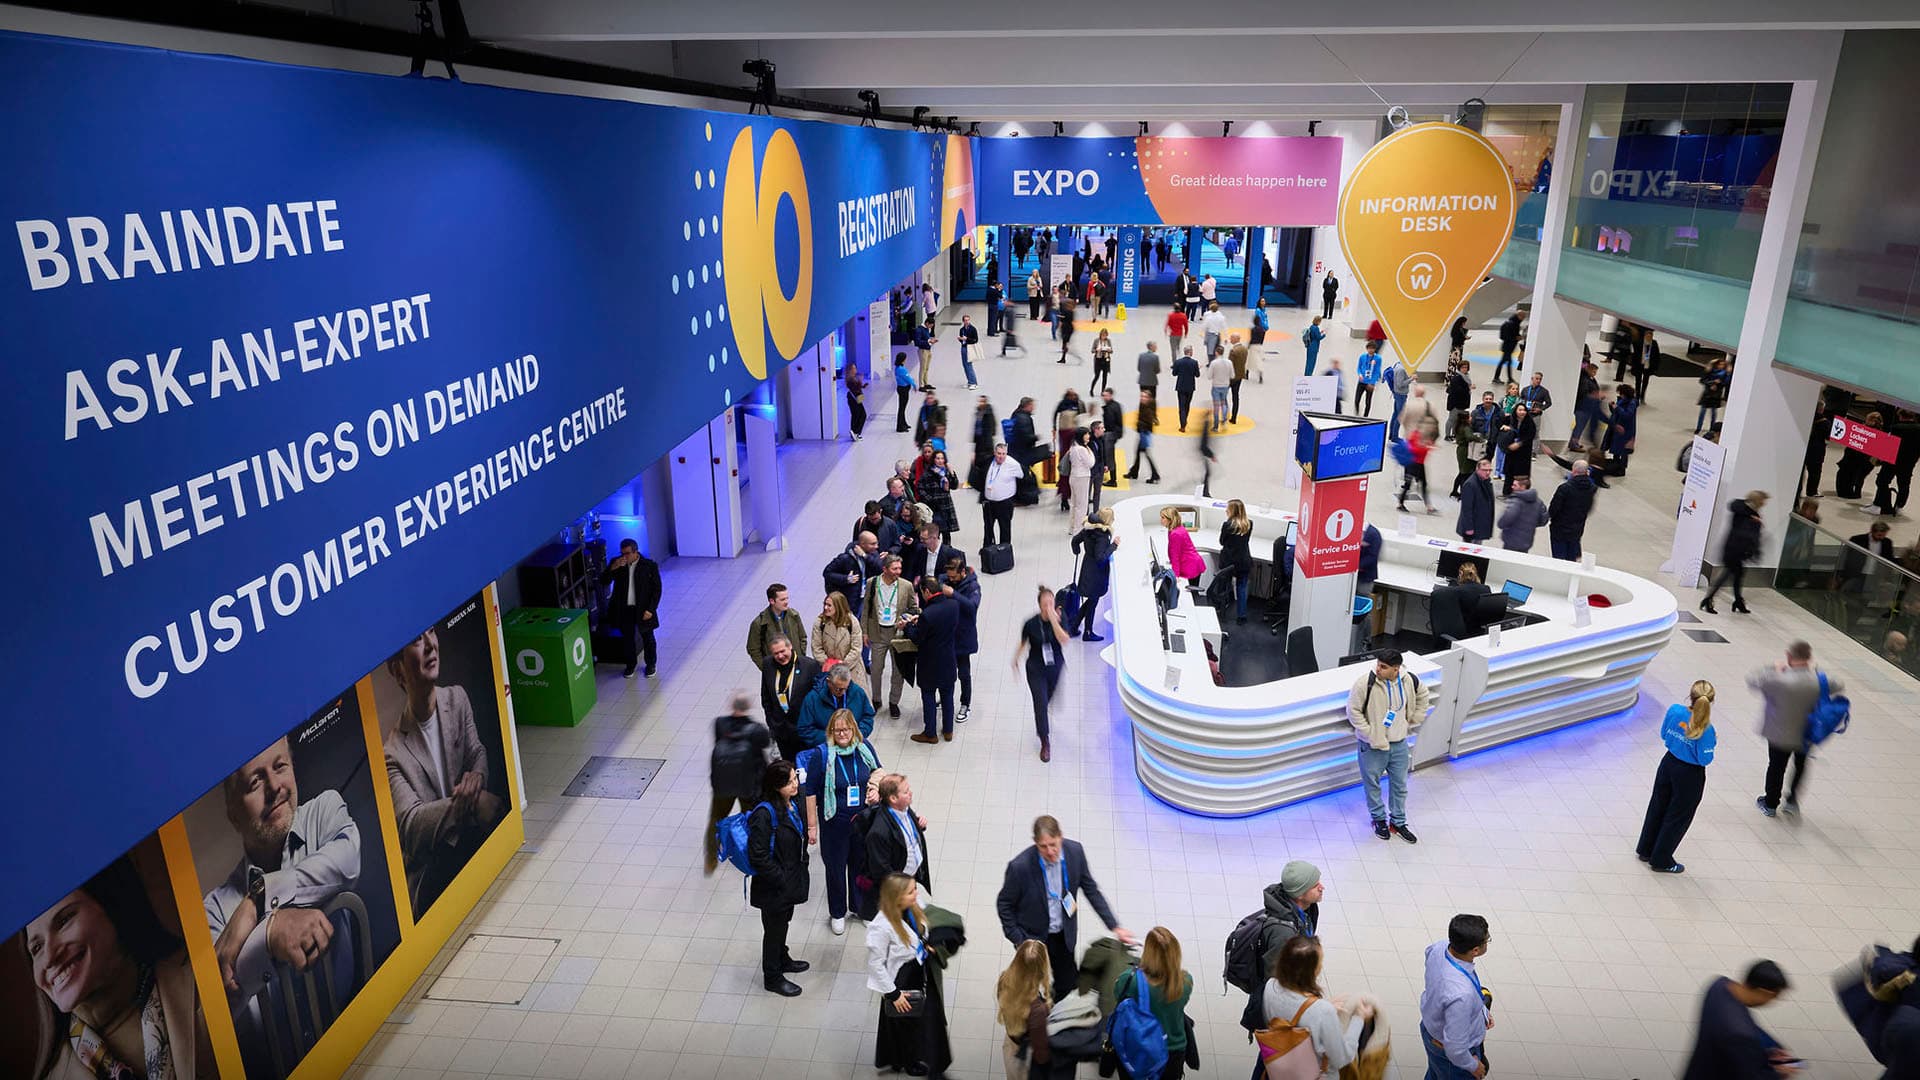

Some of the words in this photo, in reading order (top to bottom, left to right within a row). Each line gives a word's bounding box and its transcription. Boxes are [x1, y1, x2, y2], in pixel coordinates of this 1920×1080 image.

[1013, 169, 1100, 196] EXPO
[1170, 174, 1205, 187] Great
[1208, 174, 1243, 187] ideas
[1246, 174, 1294, 192] happen
[1297, 175, 1328, 188] here
[1359, 195, 1498, 215] INFORMATION
[838, 186, 916, 259] REGISTRATION
[1401, 216, 1453, 233] DESK
[16, 200, 345, 291] BRAINDATE
[65, 293, 431, 441] ASK-AN-EXPERT
[1850, 432, 1867, 443] Lockers
[1851, 424, 1876, 439] Cloakroom
[1334, 444, 1369, 457] Forever
[1849, 438, 1864, 450] Toilets
[89, 421, 360, 577] MEETINGS
[366, 400, 420, 458] ON
[425, 354, 540, 434] DEMAND
[124, 515, 392, 699] CUSTOMER
[395, 425, 556, 547] EXPERIENCE
[558, 386, 629, 452] CENTRE
[1312, 545, 1340, 556] Service
[1342, 542, 1360, 552] Desk
[299, 707, 339, 743] McLaren
